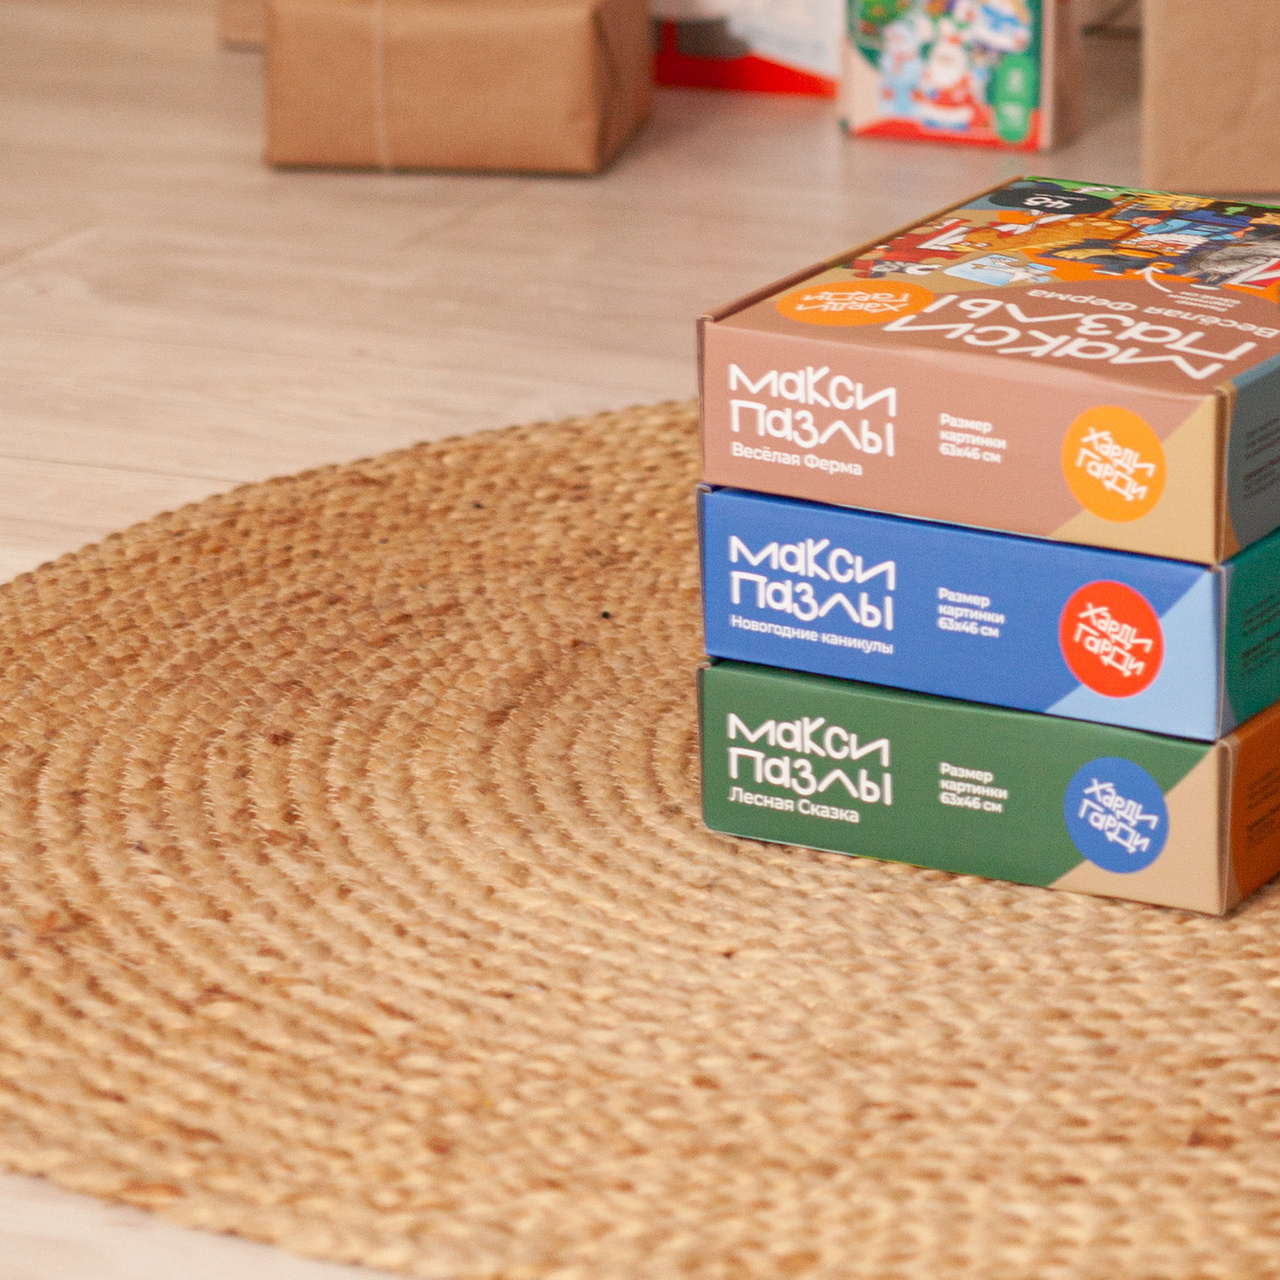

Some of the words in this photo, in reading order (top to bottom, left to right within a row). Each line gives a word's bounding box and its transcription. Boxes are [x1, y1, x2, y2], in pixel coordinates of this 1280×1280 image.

[1026, 288, 1138, 313] Ферма
[939, 413, 993, 434] Размер
[939, 429, 1007, 450] картинки
[731, 441, 801, 466] Весёлая
[804, 454, 863, 476] Ферма
[981, 451, 1002, 463] см
[938, 587, 990, 608] Размер
[938, 604, 1005, 624] картинки
[730, 614, 818, 641] Новогодние
[820, 631, 894, 655] каникулы
[980, 626, 1000, 638] см
[939, 762, 994, 783] Размер
[939, 779, 1008, 800] картинки
[729, 786, 794, 812] Лесная
[799, 798, 860, 823] Сказка
[982, 800, 1002, 813] см
